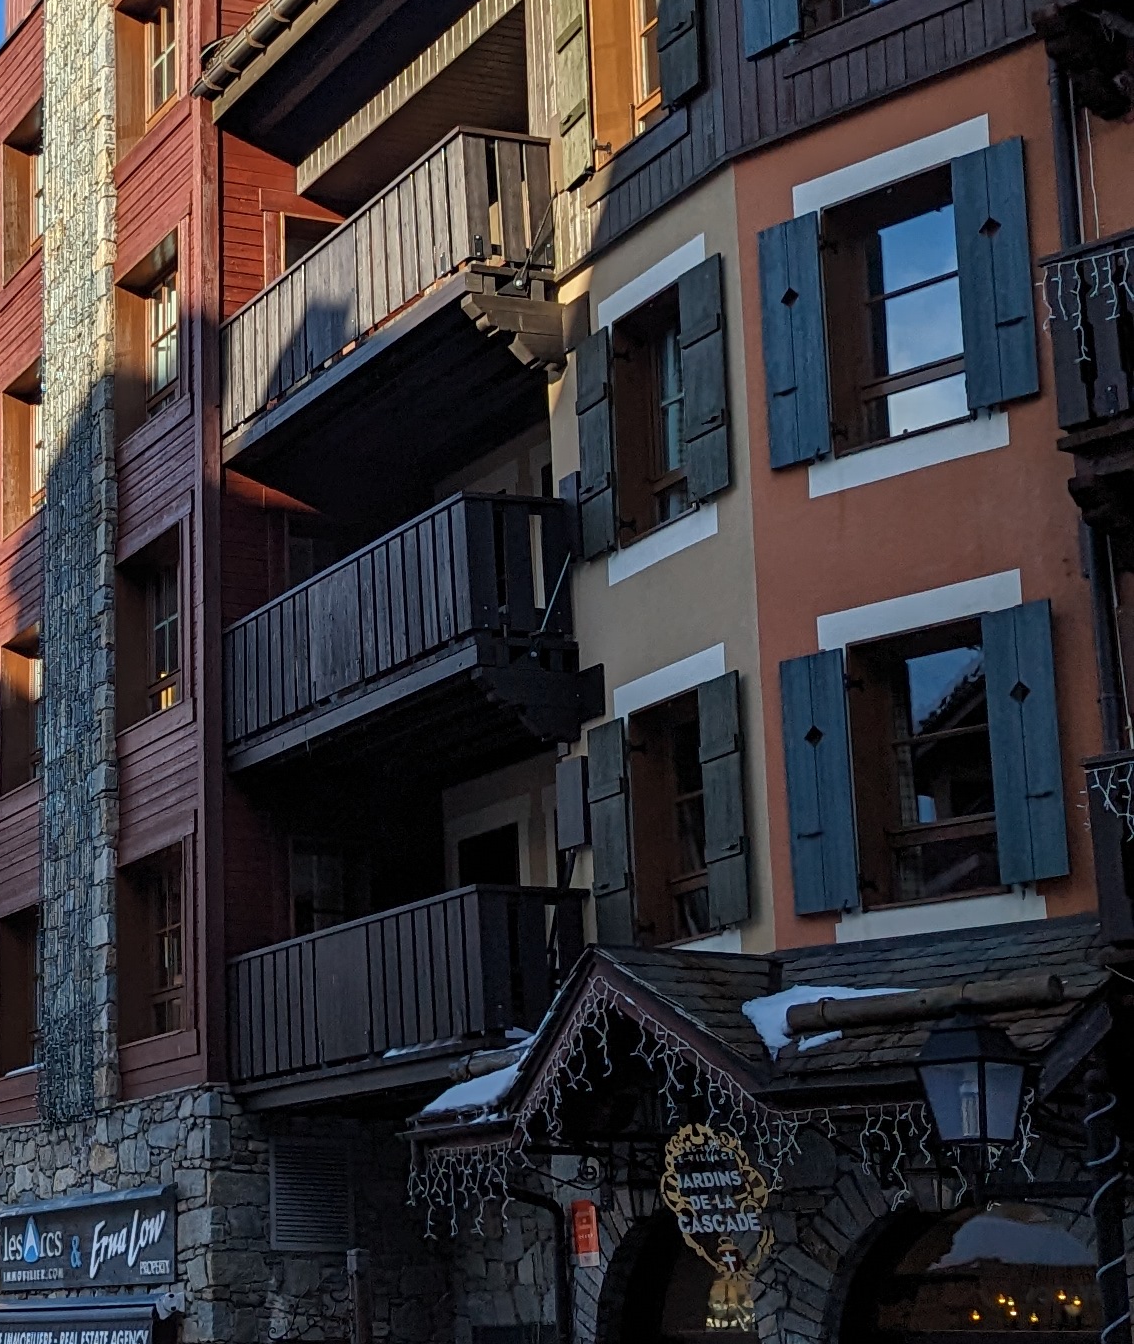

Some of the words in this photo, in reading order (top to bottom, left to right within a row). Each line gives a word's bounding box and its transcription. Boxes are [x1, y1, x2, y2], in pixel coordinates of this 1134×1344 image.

[678, 1170, 742, 1189] JARDINS
[690, 1194, 712, 1210] DE
[715, 1194, 736, 1209] LA
[678, 1212, 761, 1234] CASCADE
[127, 1209, 166, 1267] Low
